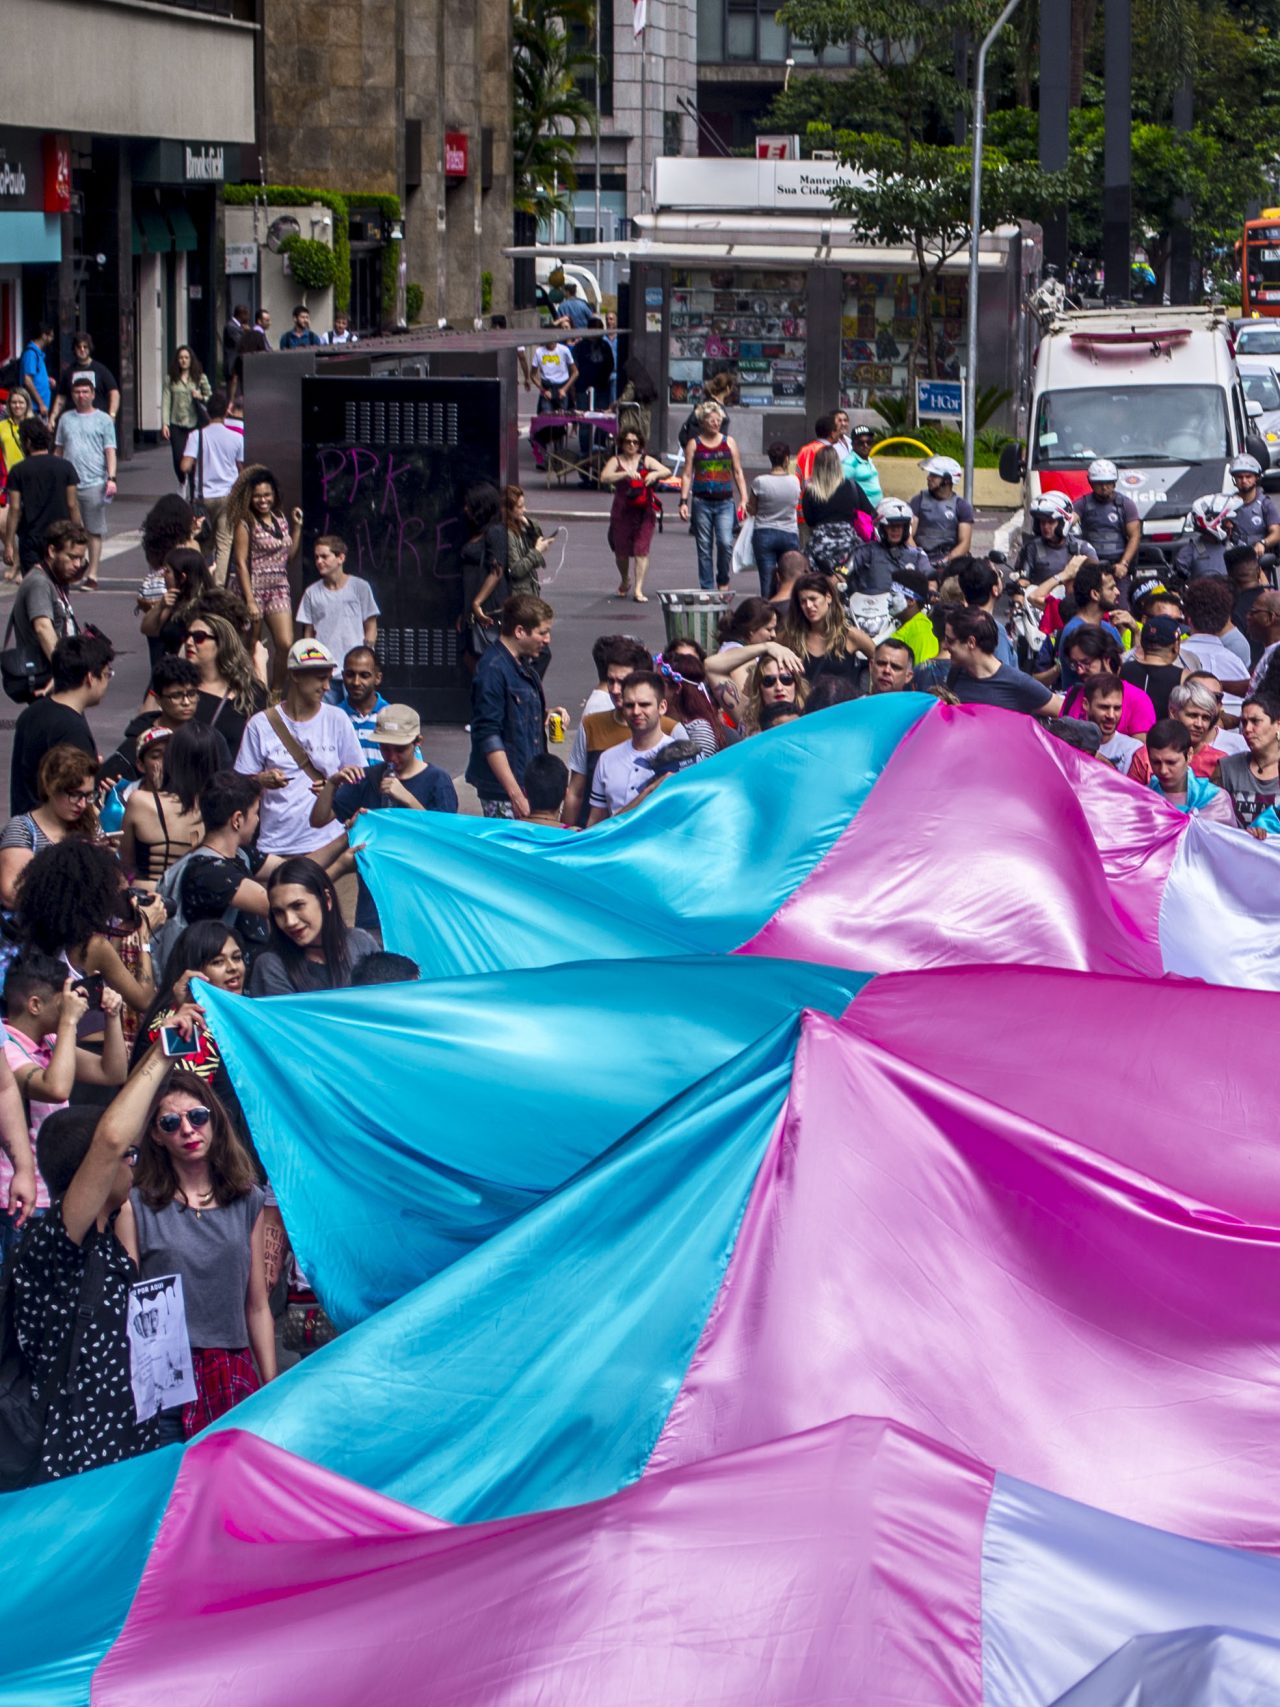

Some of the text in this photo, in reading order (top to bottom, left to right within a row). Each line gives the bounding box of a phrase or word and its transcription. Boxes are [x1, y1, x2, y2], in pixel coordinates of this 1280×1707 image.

[186, 146, 224, 179] Brooksfield
[800, 175, 851, 187] Mantenha
[777, 186, 833, 197] Sua Cidad
[738, 359, 768, 368] WELCOME
[931, 394, 961, 409] HCor
